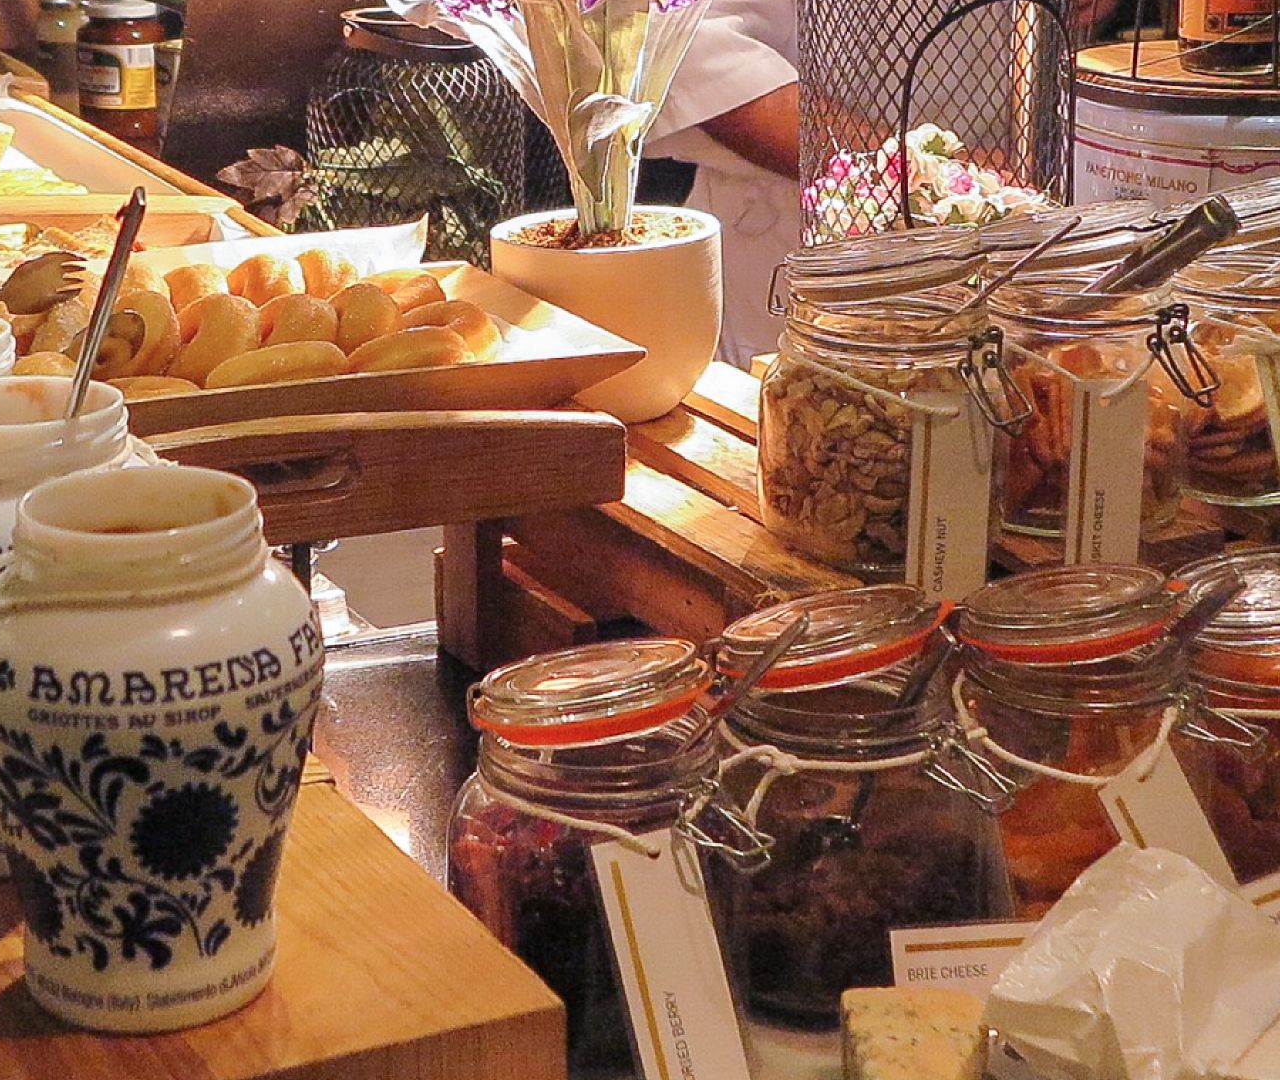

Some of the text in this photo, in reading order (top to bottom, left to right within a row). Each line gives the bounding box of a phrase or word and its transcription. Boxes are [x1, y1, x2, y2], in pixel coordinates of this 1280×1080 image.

[1147, 174, 1198, 194] MILANO
[932, 517, 948, 592] CASHEW NUT
[28, 647, 282, 706] AMARENA
[27, 706, 120, 729] GRIOTTES
[164, 705, 222, 728] SIROP
[907, 963, 989, 982] BRIE CHEESE
[663, 990, 686, 1038] BERRY
